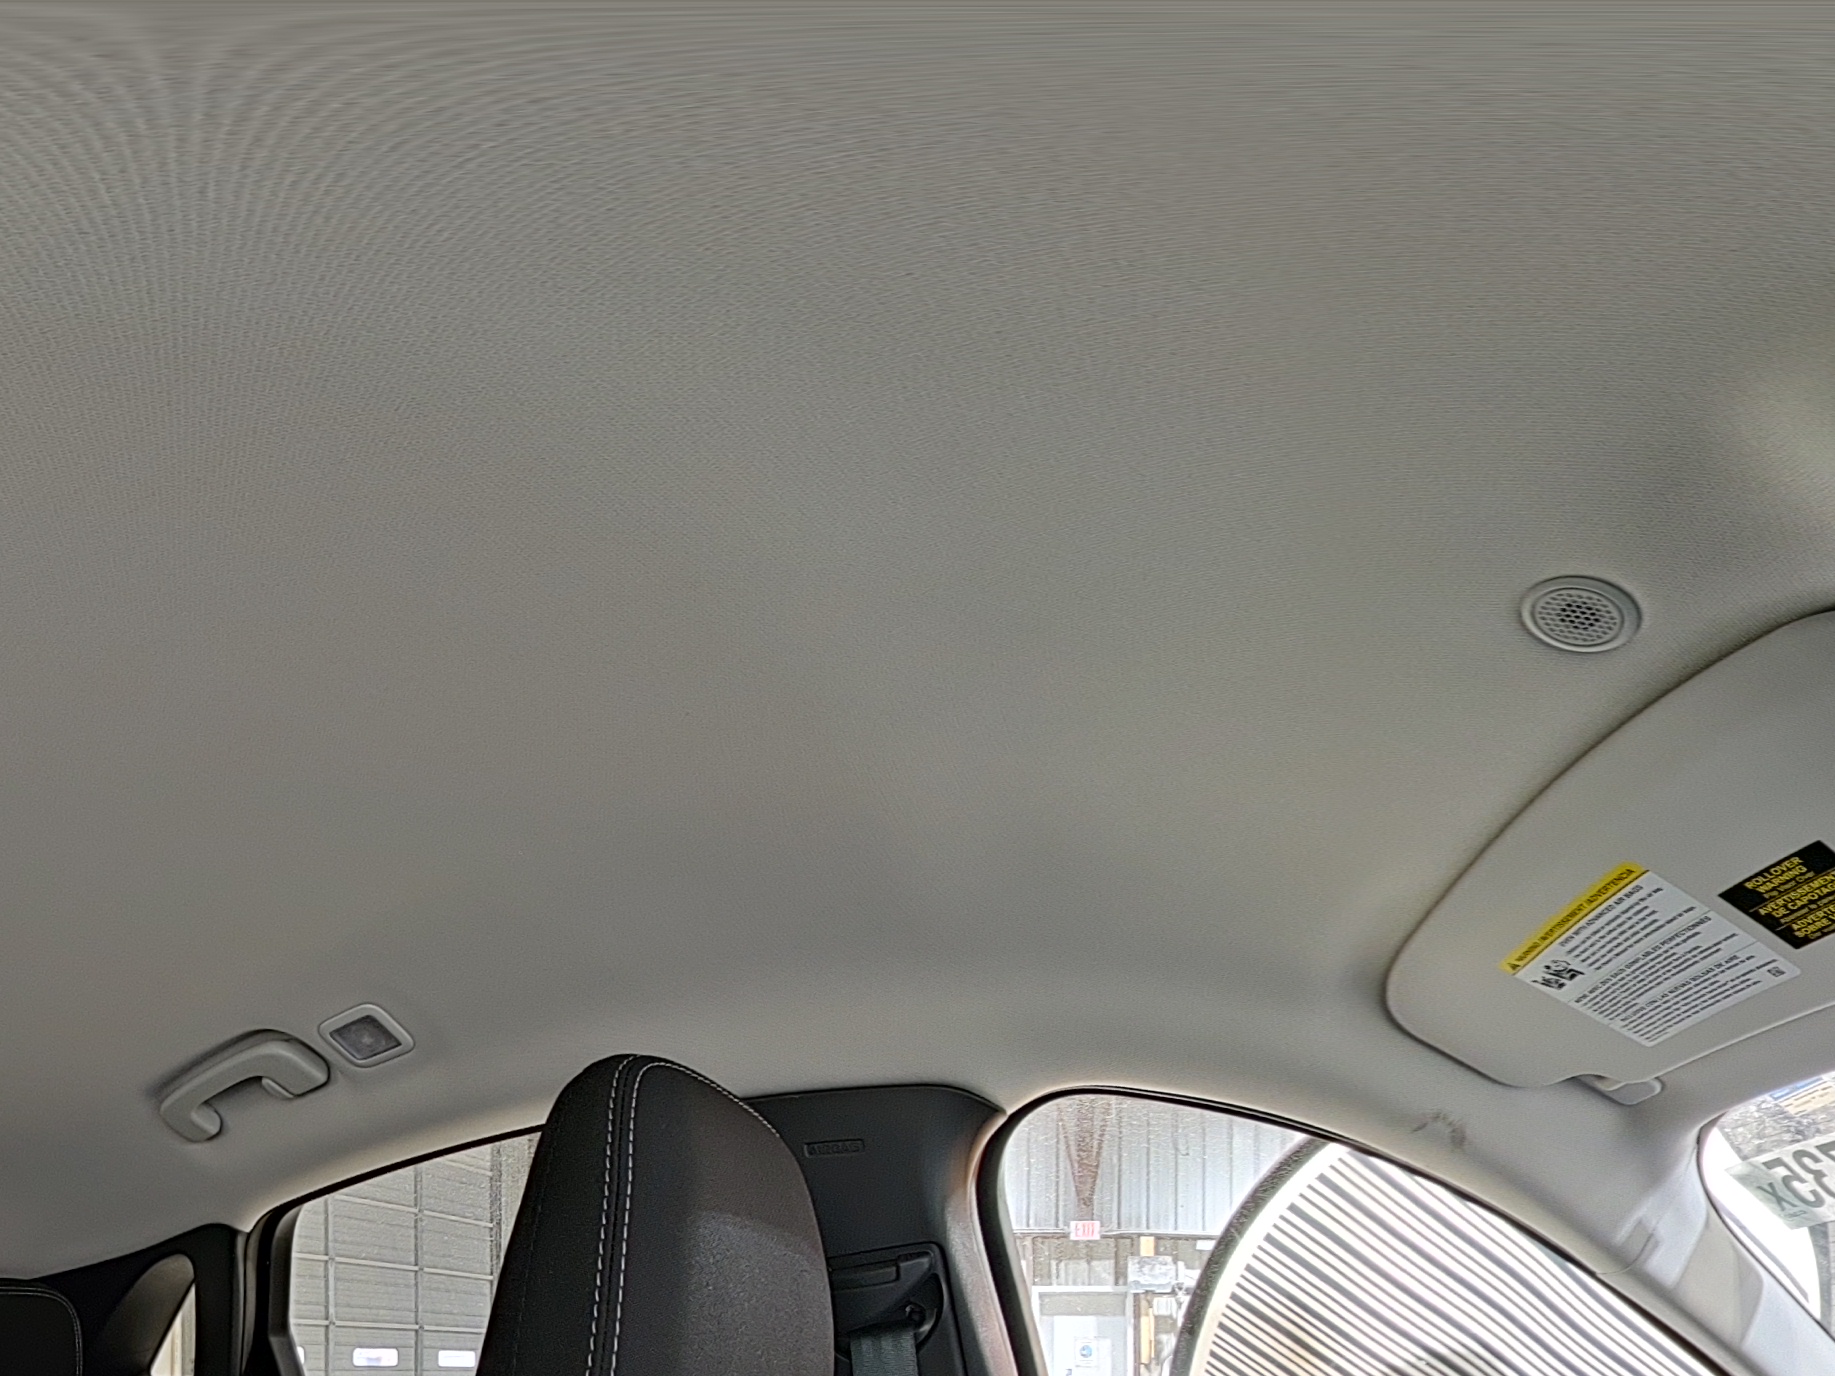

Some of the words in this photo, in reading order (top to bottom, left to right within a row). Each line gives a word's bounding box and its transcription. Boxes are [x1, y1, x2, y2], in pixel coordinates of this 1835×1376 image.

[1742, 855, 1804, 890] ROLLOVER
[1754, 863, 1808, 894] WARNING
[1770, 906, 1790, 918] DE
[1792, 917, 1833, 938] SOBRE
[1075, 1221, 1096, 1237] EXIT
